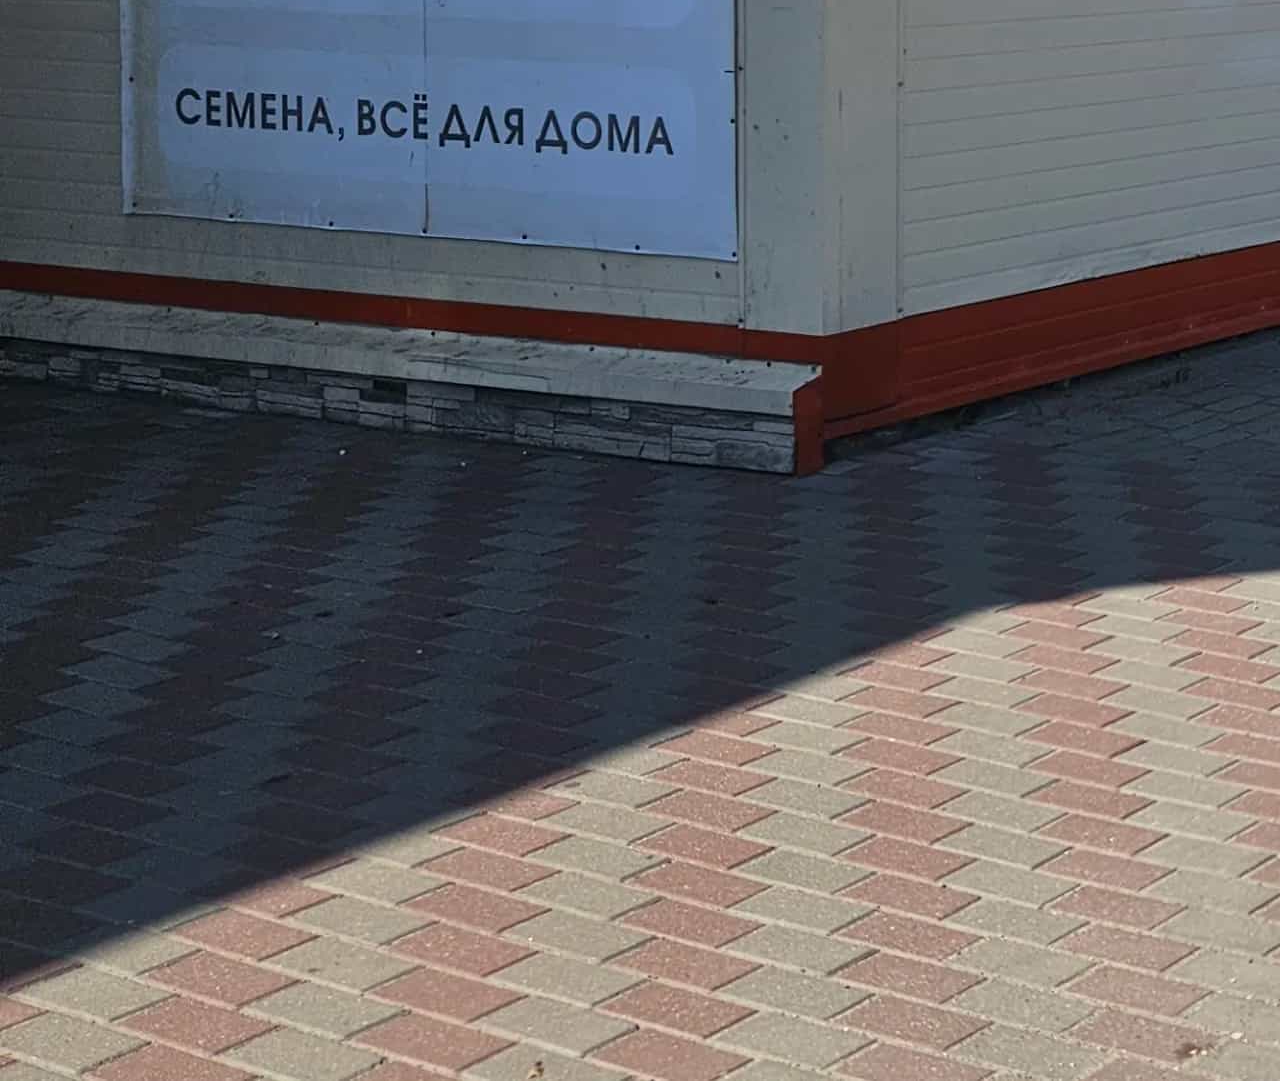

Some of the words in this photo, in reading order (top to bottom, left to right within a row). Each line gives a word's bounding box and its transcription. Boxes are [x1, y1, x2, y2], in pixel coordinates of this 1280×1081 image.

[175, 87, 345, 141] СЕМЕНА,
[357, 93, 428, 140] ВСЁ
[438, 104, 524, 149] ДЛЯ
[535, 110, 674, 156] ДОМА
